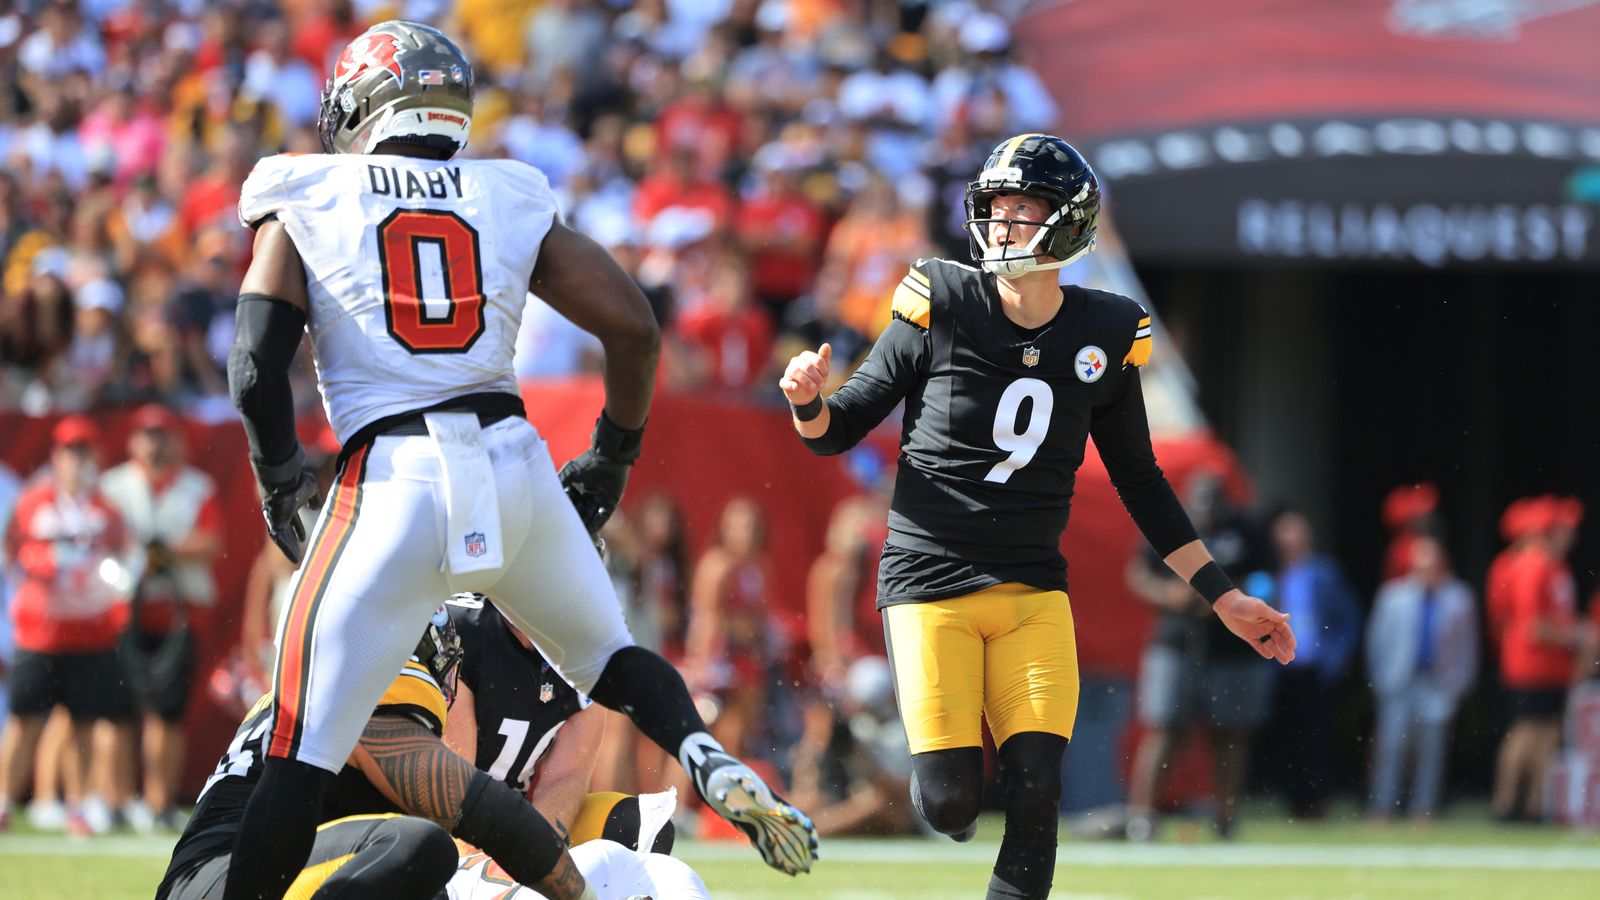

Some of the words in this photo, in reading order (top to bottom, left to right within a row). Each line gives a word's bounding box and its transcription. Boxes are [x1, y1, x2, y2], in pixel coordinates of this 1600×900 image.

[368, 164, 463, 199] DIABY
[376, 207, 487, 355] 0
[984, 377, 1054, 484] 9
